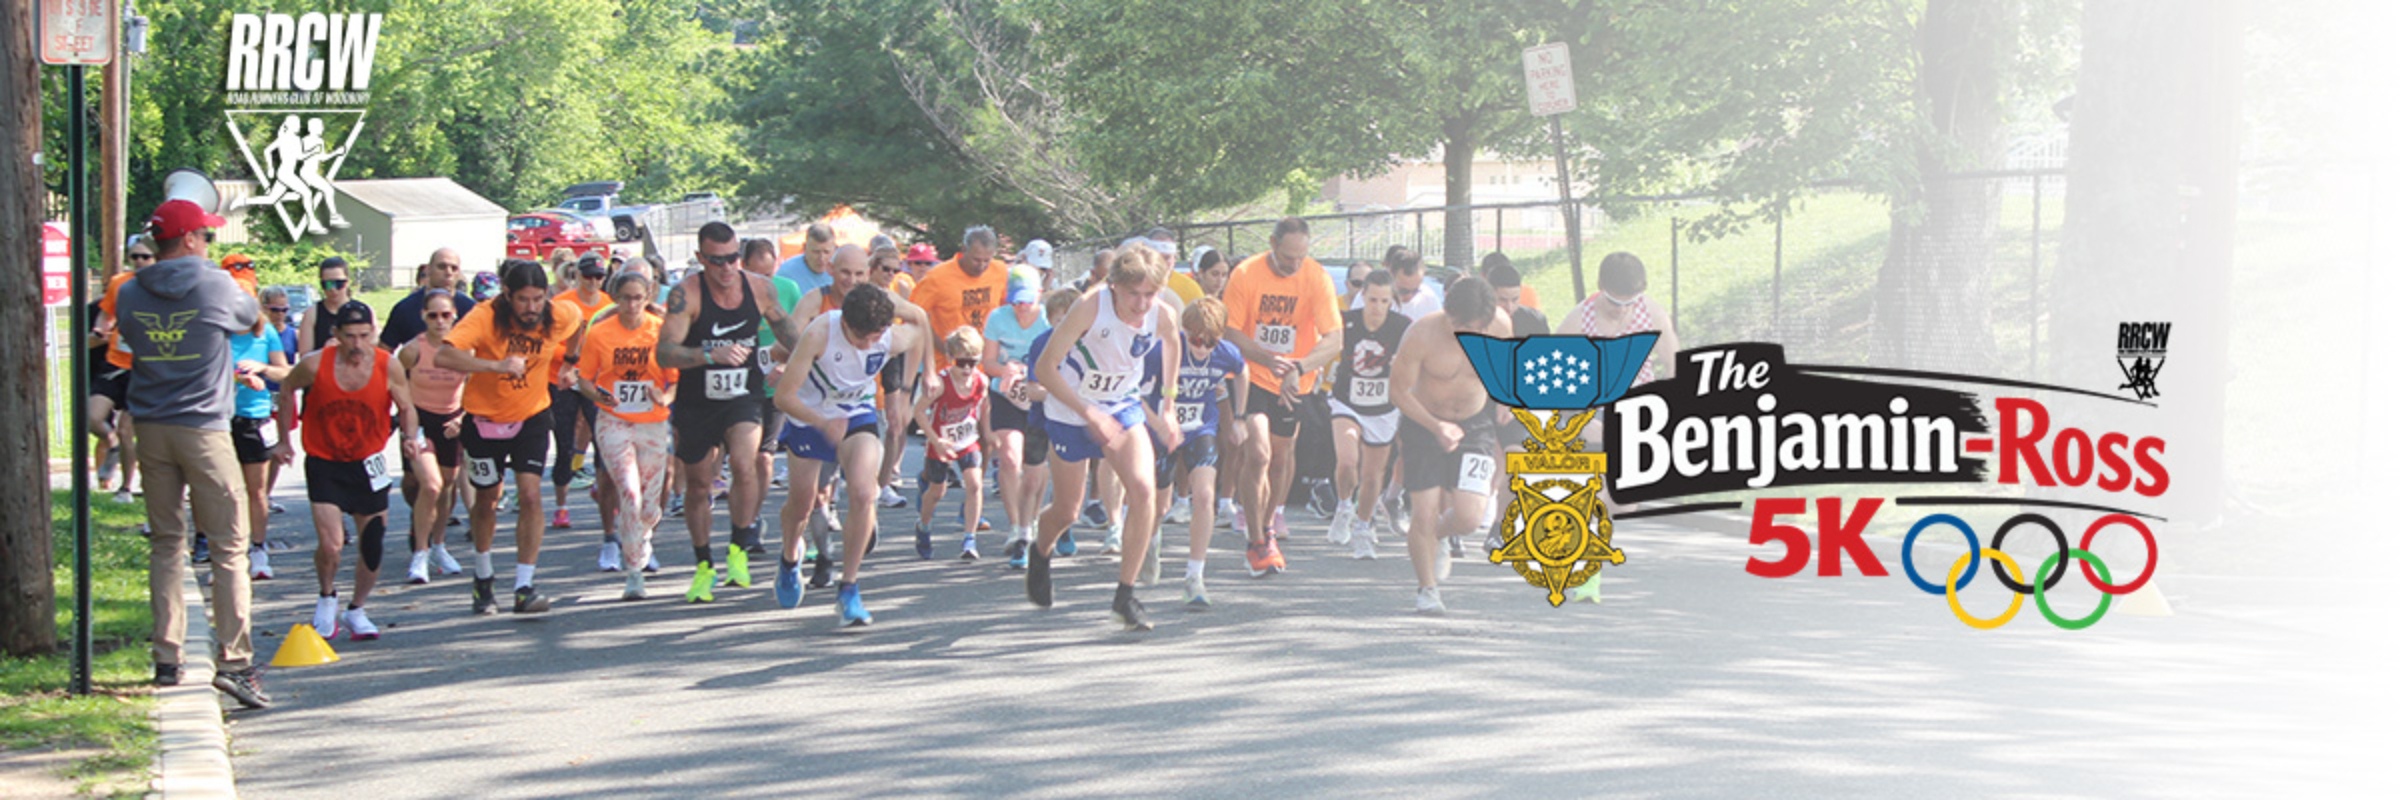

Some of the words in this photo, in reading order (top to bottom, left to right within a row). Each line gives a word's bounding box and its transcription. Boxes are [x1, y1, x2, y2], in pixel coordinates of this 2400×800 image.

[1538, 51, 1553, 64] NO
[962, 288, 991, 307] RRCW
[1259, 294, 1298, 314] RRCW
[506, 333, 544, 354] RRCW
[1260, 326, 1290, 345] 308
[613, 347, 650, 366] RRCW
[713, 373, 742, 391] 314
[1089, 373, 1125, 393] 317
[1357, 381, 1385, 397] 320
[620, 384, 647, 402] 571
[1176, 405, 1198, 425] 83
